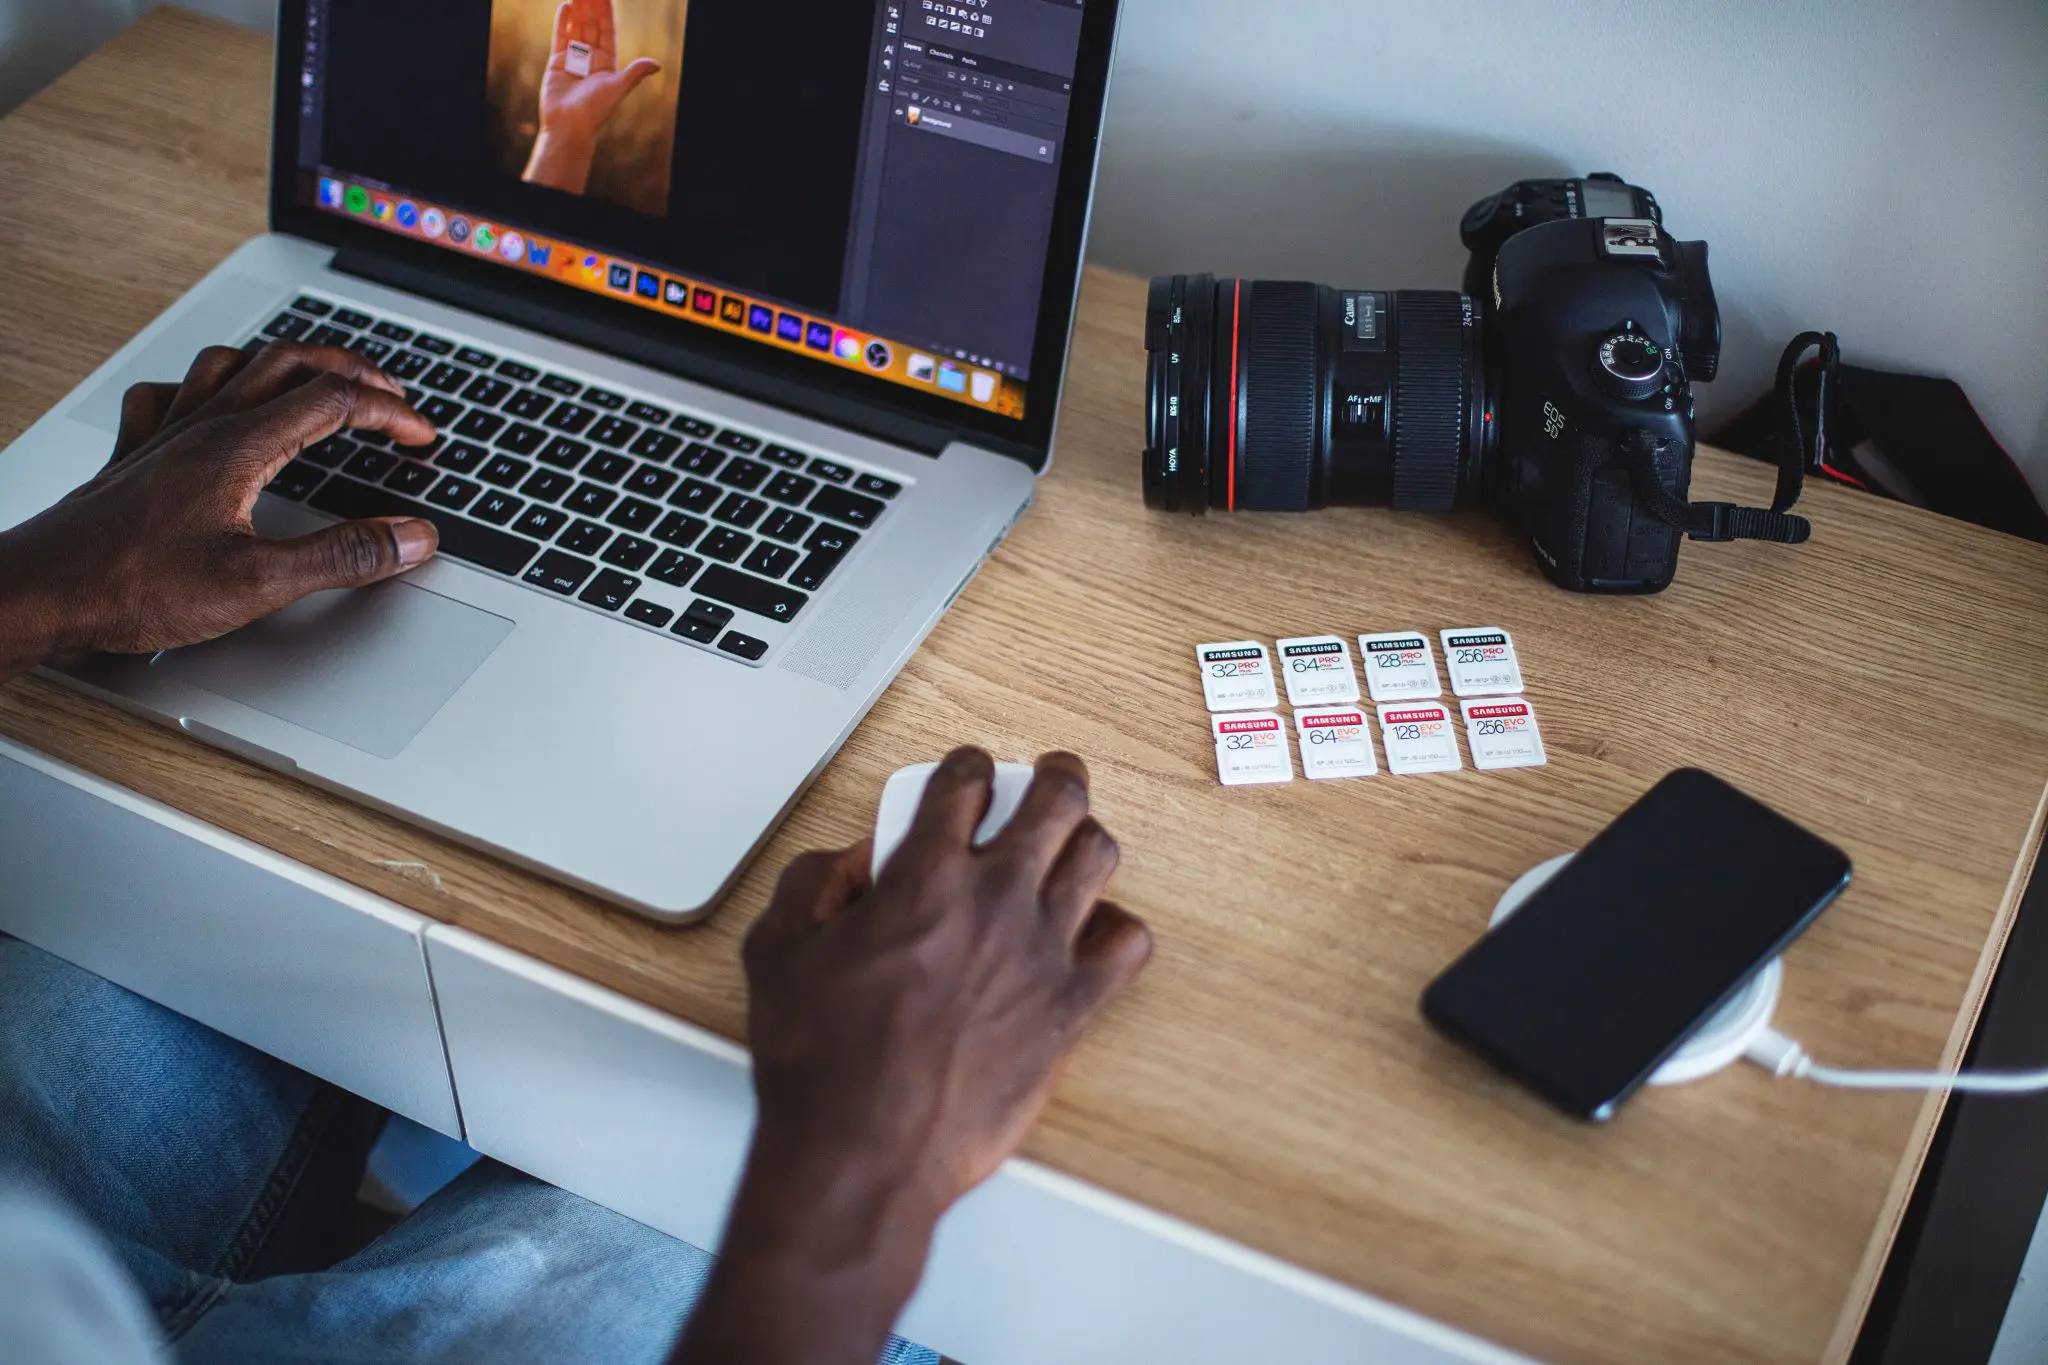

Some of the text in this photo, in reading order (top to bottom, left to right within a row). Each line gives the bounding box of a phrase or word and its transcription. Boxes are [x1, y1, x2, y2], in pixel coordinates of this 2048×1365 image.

[929, 49, 954, 60] Channels
[962, 57, 977, 66] Paths
[527, 239, 551, 267] W
[1344, 298, 1354, 326] Canon
[1171, 353, 1179, 364] UV
[1664, 348, 1672, 360] ON
[1369, 395, 1382, 403] MF
[1543, 401, 1565, 429] EOS
[1543, 419, 1559, 439] 5D
[1168, 448, 1176, 472] HOYA
[554, 578, 574, 588] cmd
[1370, 641, 1420, 650] SAMSUNG
[1452, 636, 1501, 645] SAMSUNG
[1208, 650, 1258, 660] SAMSUNG
[1289, 644, 1338, 654] SAMSUNG
[1456, 647, 1504, 663] 256 PRO
[1292, 658, 1320, 673] 64
[1374, 653, 1401, 668] 128
[1212, 661, 1260, 678] 32 PRO
[1389, 711, 1440, 720] SAMSUNG
[1472, 706, 1523, 715] SAMSUNG
[1223, 721, 1274, 730] SAMSUNG
[1306, 716, 1357, 725] SAMSUNG
[1476, 720, 1505, 735] 256
[1310, 729, 1338, 744] 64
[1392, 723, 1442, 740] 128 EVO
[1226, 734, 1254, 750] 32
